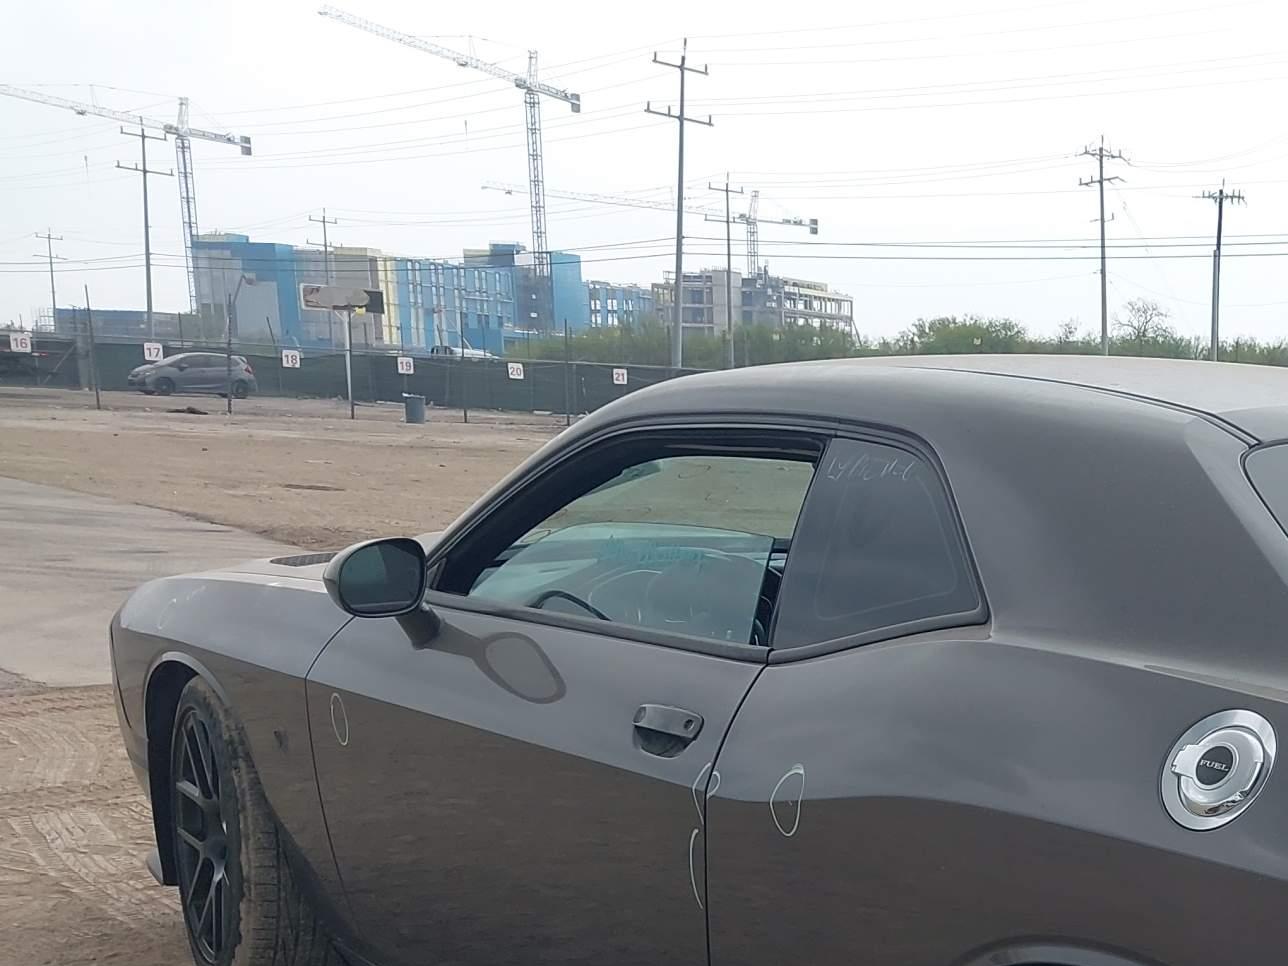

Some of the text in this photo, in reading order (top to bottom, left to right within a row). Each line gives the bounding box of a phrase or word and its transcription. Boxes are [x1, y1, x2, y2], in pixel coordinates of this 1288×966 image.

[12, 337, 28, 349] 16
[145, 347, 161, 358] 17
[284, 354, 298, 365] 18
[399, 361, 412, 371] 19
[510, 366, 522, 376] 20
[615, 372, 625, 382] 21
[1200, 759, 1230, 772] FUEL
